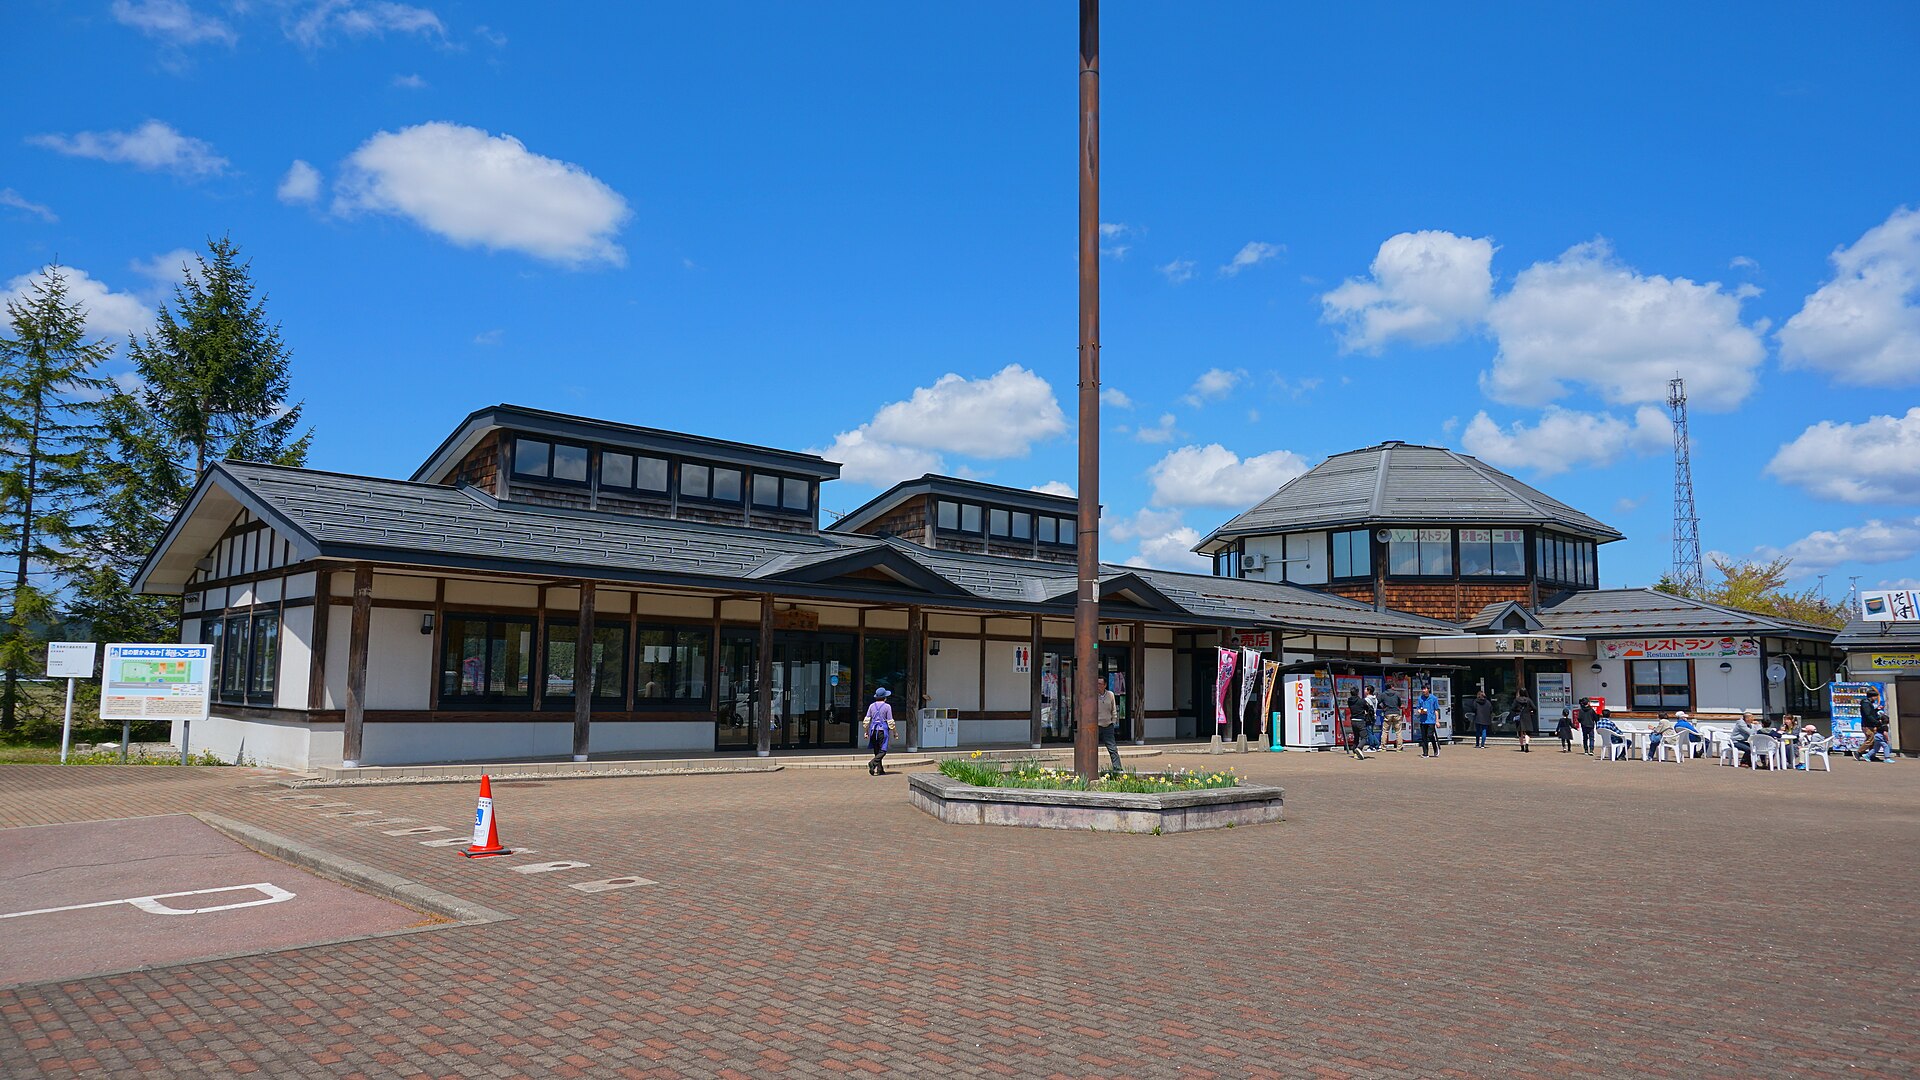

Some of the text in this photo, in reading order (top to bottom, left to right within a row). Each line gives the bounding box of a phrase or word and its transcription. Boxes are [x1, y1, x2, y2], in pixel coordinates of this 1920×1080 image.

[1894, 592, 1914, 619] そば
[1240, 633, 1270, 647] 売店
[1644, 639, 1715, 651] レストラン
